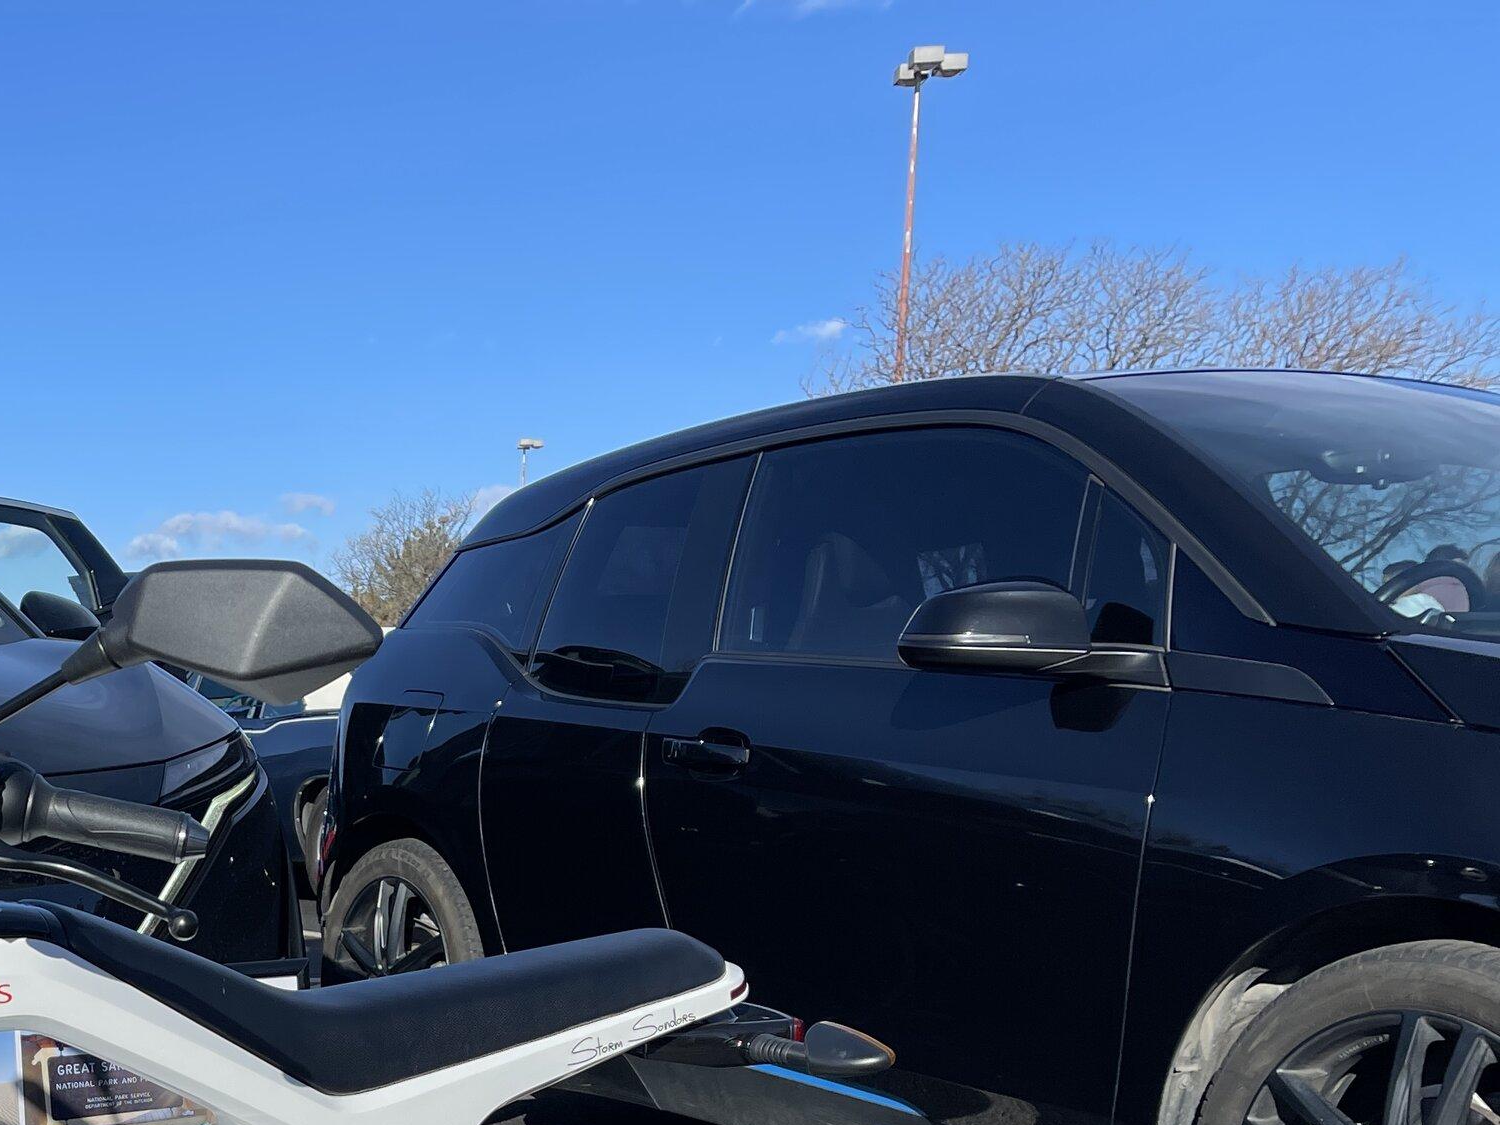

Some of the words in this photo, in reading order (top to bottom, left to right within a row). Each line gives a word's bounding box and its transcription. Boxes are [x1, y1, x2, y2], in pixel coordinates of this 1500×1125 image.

[57, 1062, 95, 1076] GREAT
[56, 1080, 95, 1091] NATIONAL
[99, 1078, 118, 1087] PARK
[122, 1076, 137, 1084] AND
[87, 1095, 112, 1103] NATIONAL
